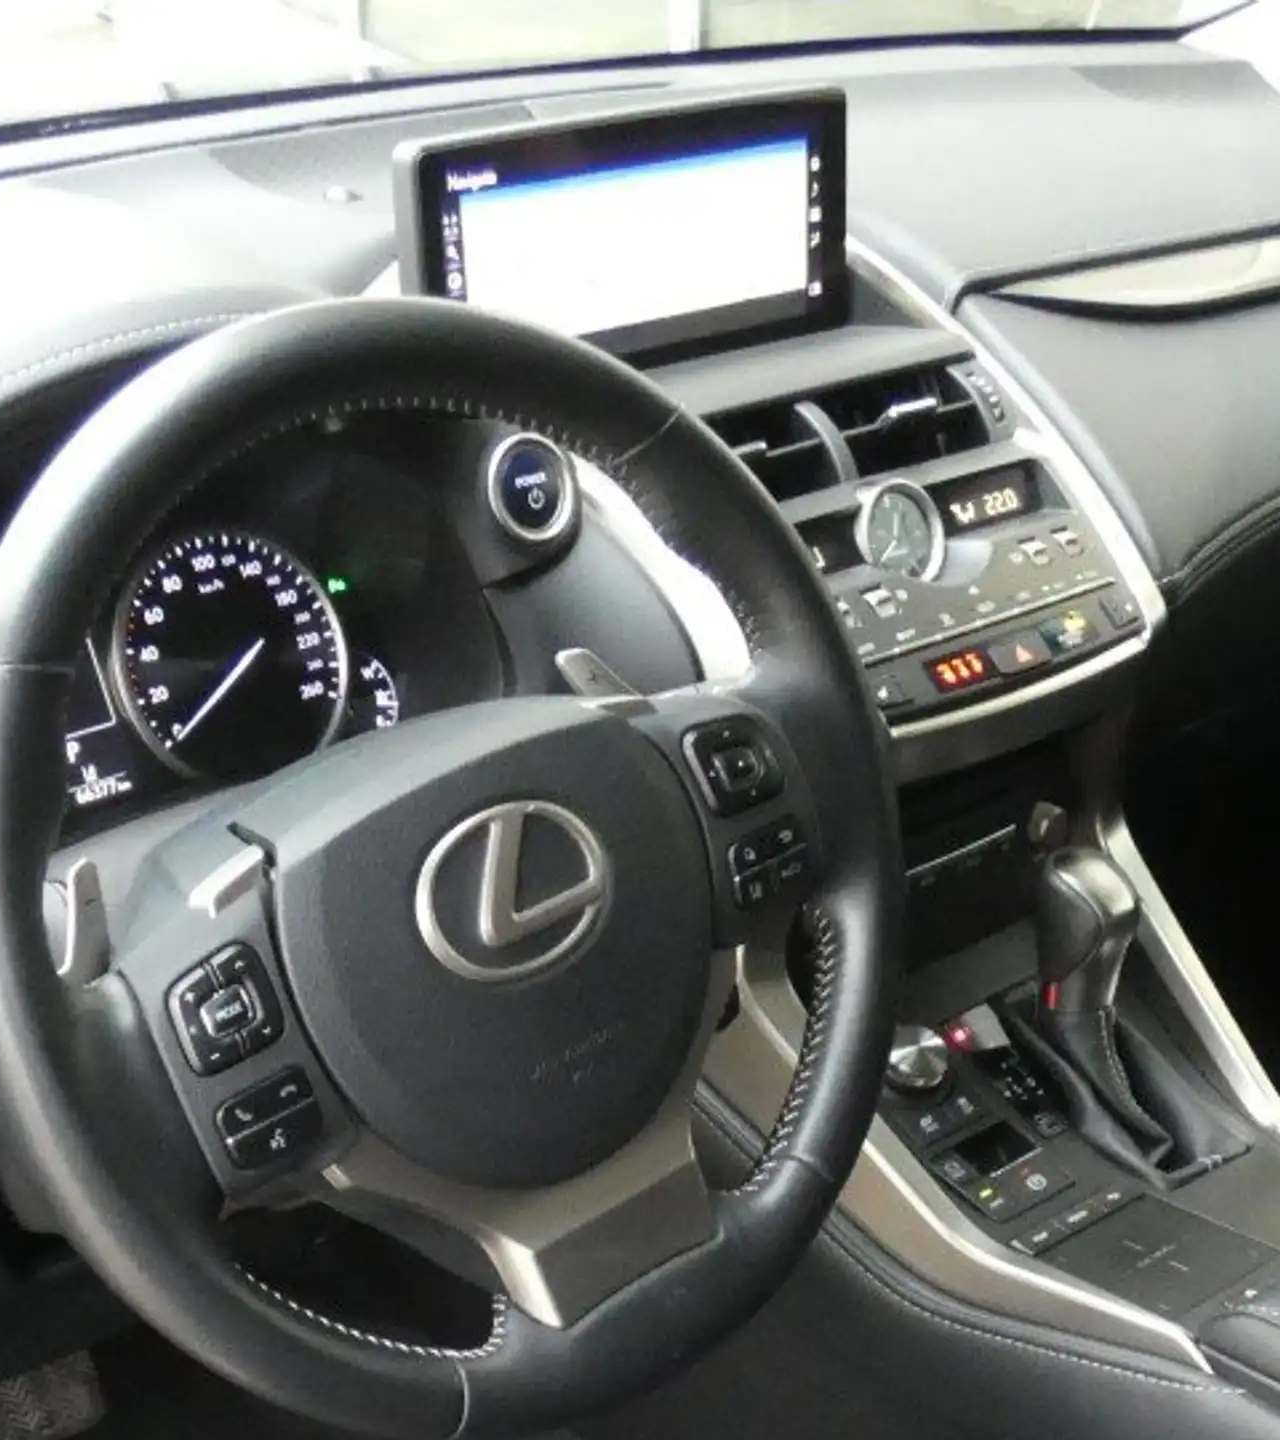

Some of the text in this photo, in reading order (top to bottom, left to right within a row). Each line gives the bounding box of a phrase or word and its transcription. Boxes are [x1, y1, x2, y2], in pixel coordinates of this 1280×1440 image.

[191, 553, 215, 572] 100
[239, 560, 262, 578] 140
[162, 574, 183, 593] 80
[198, 579, 225, 593] km/h
[144, 606, 164, 625] 60
[148, 685, 169, 704] 20
[66, 740, 81, 764] P
